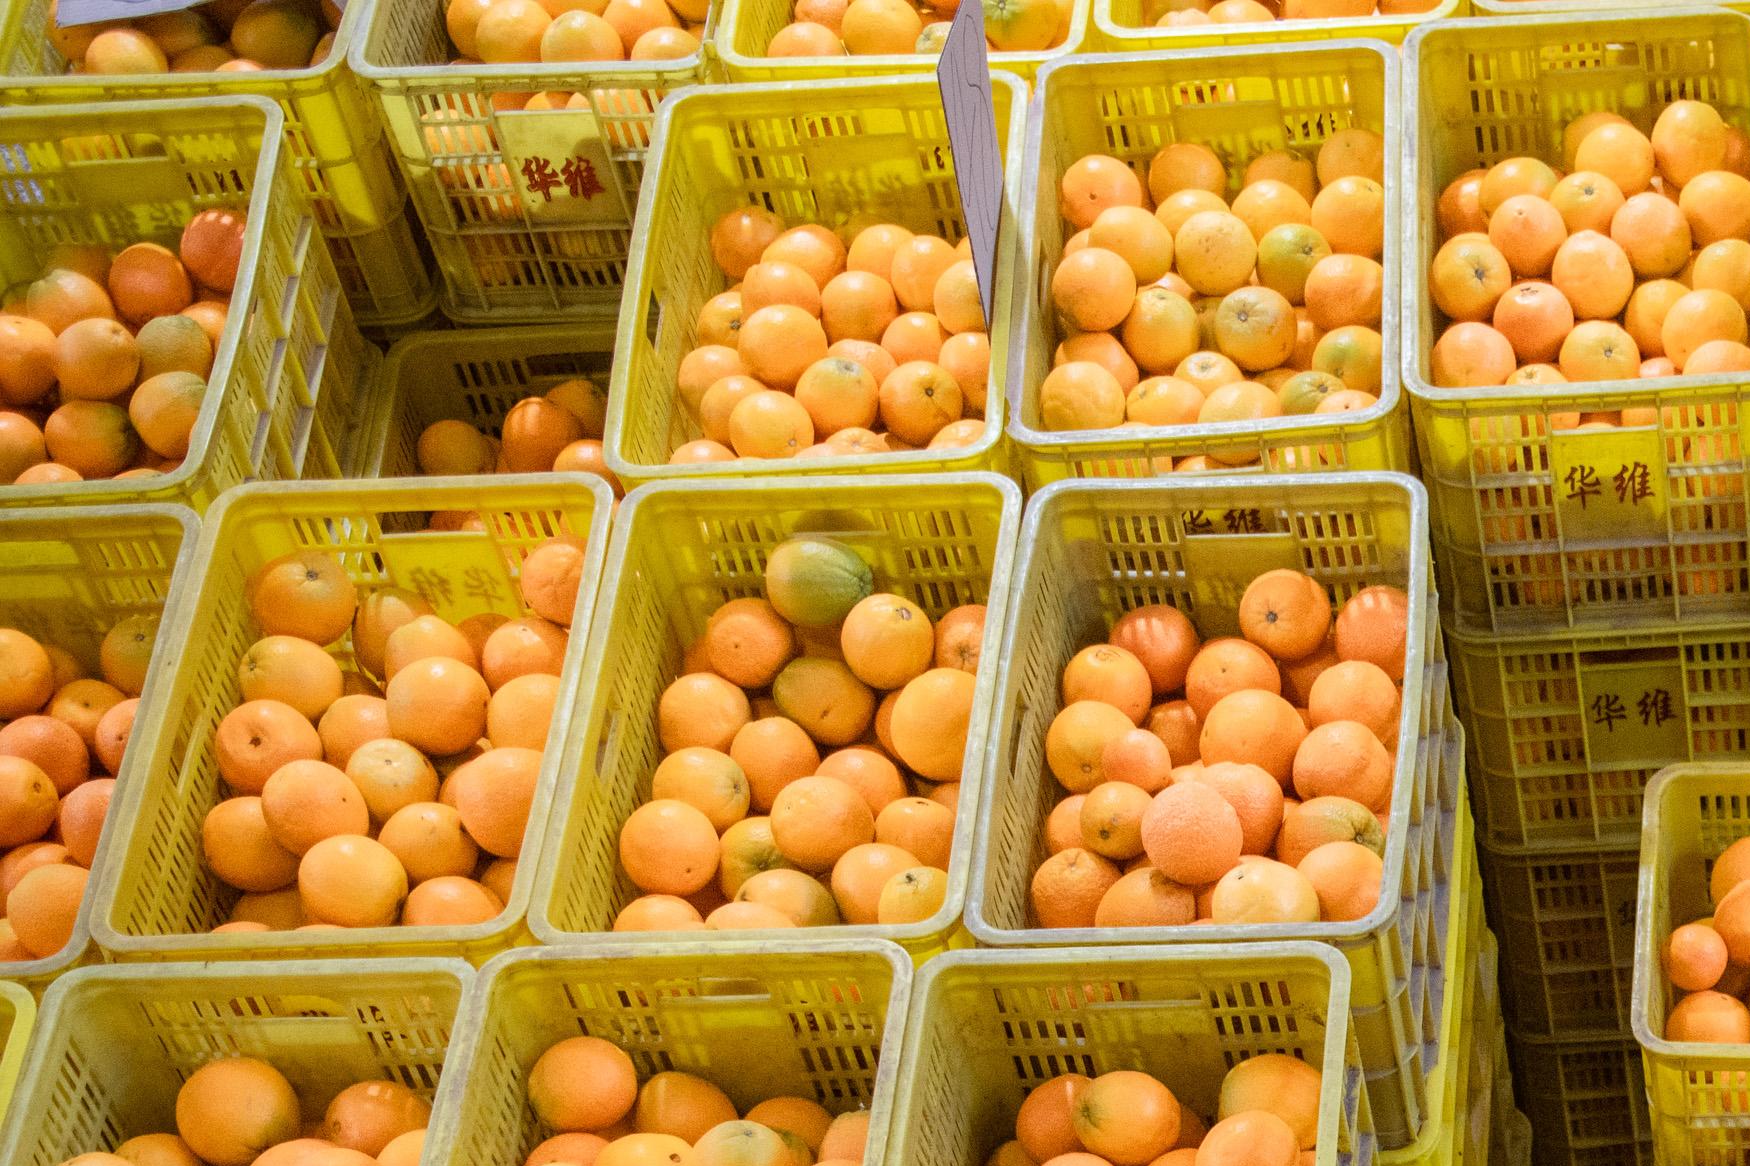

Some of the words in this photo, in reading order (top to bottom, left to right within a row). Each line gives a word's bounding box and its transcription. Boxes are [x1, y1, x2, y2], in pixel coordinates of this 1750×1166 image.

[521, 155, 606, 202] 华维
[1563, 461, 1656, 510] 华维
[1591, 688, 1678, 732] 华维
